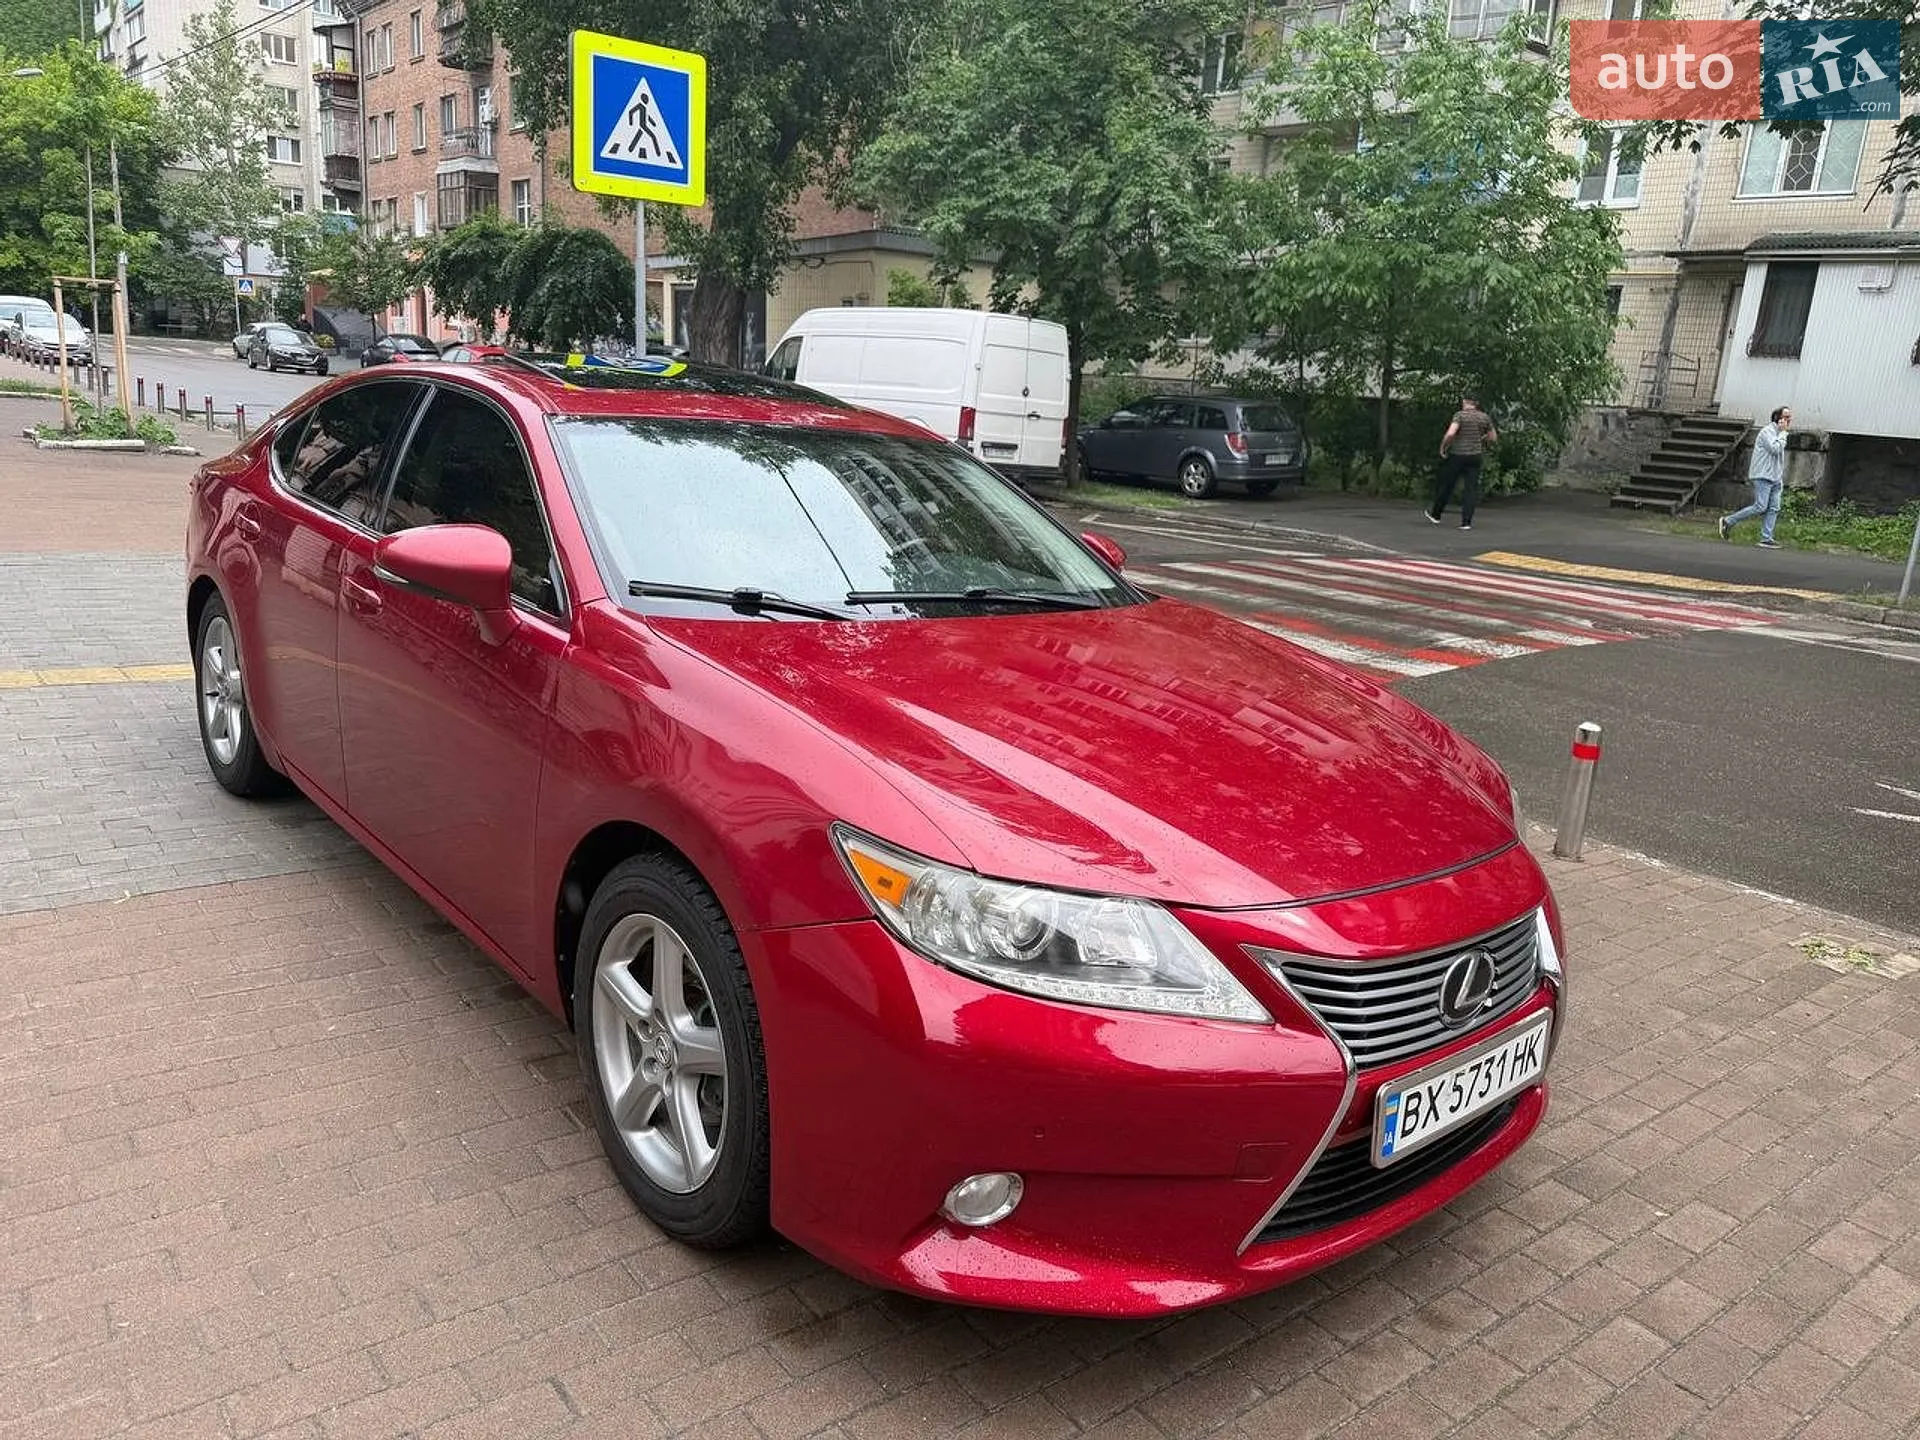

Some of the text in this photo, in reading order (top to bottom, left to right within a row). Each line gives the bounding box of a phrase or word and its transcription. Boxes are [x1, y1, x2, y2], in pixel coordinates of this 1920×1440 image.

[1401, 1028, 1544, 1138] BX 5731 HK
